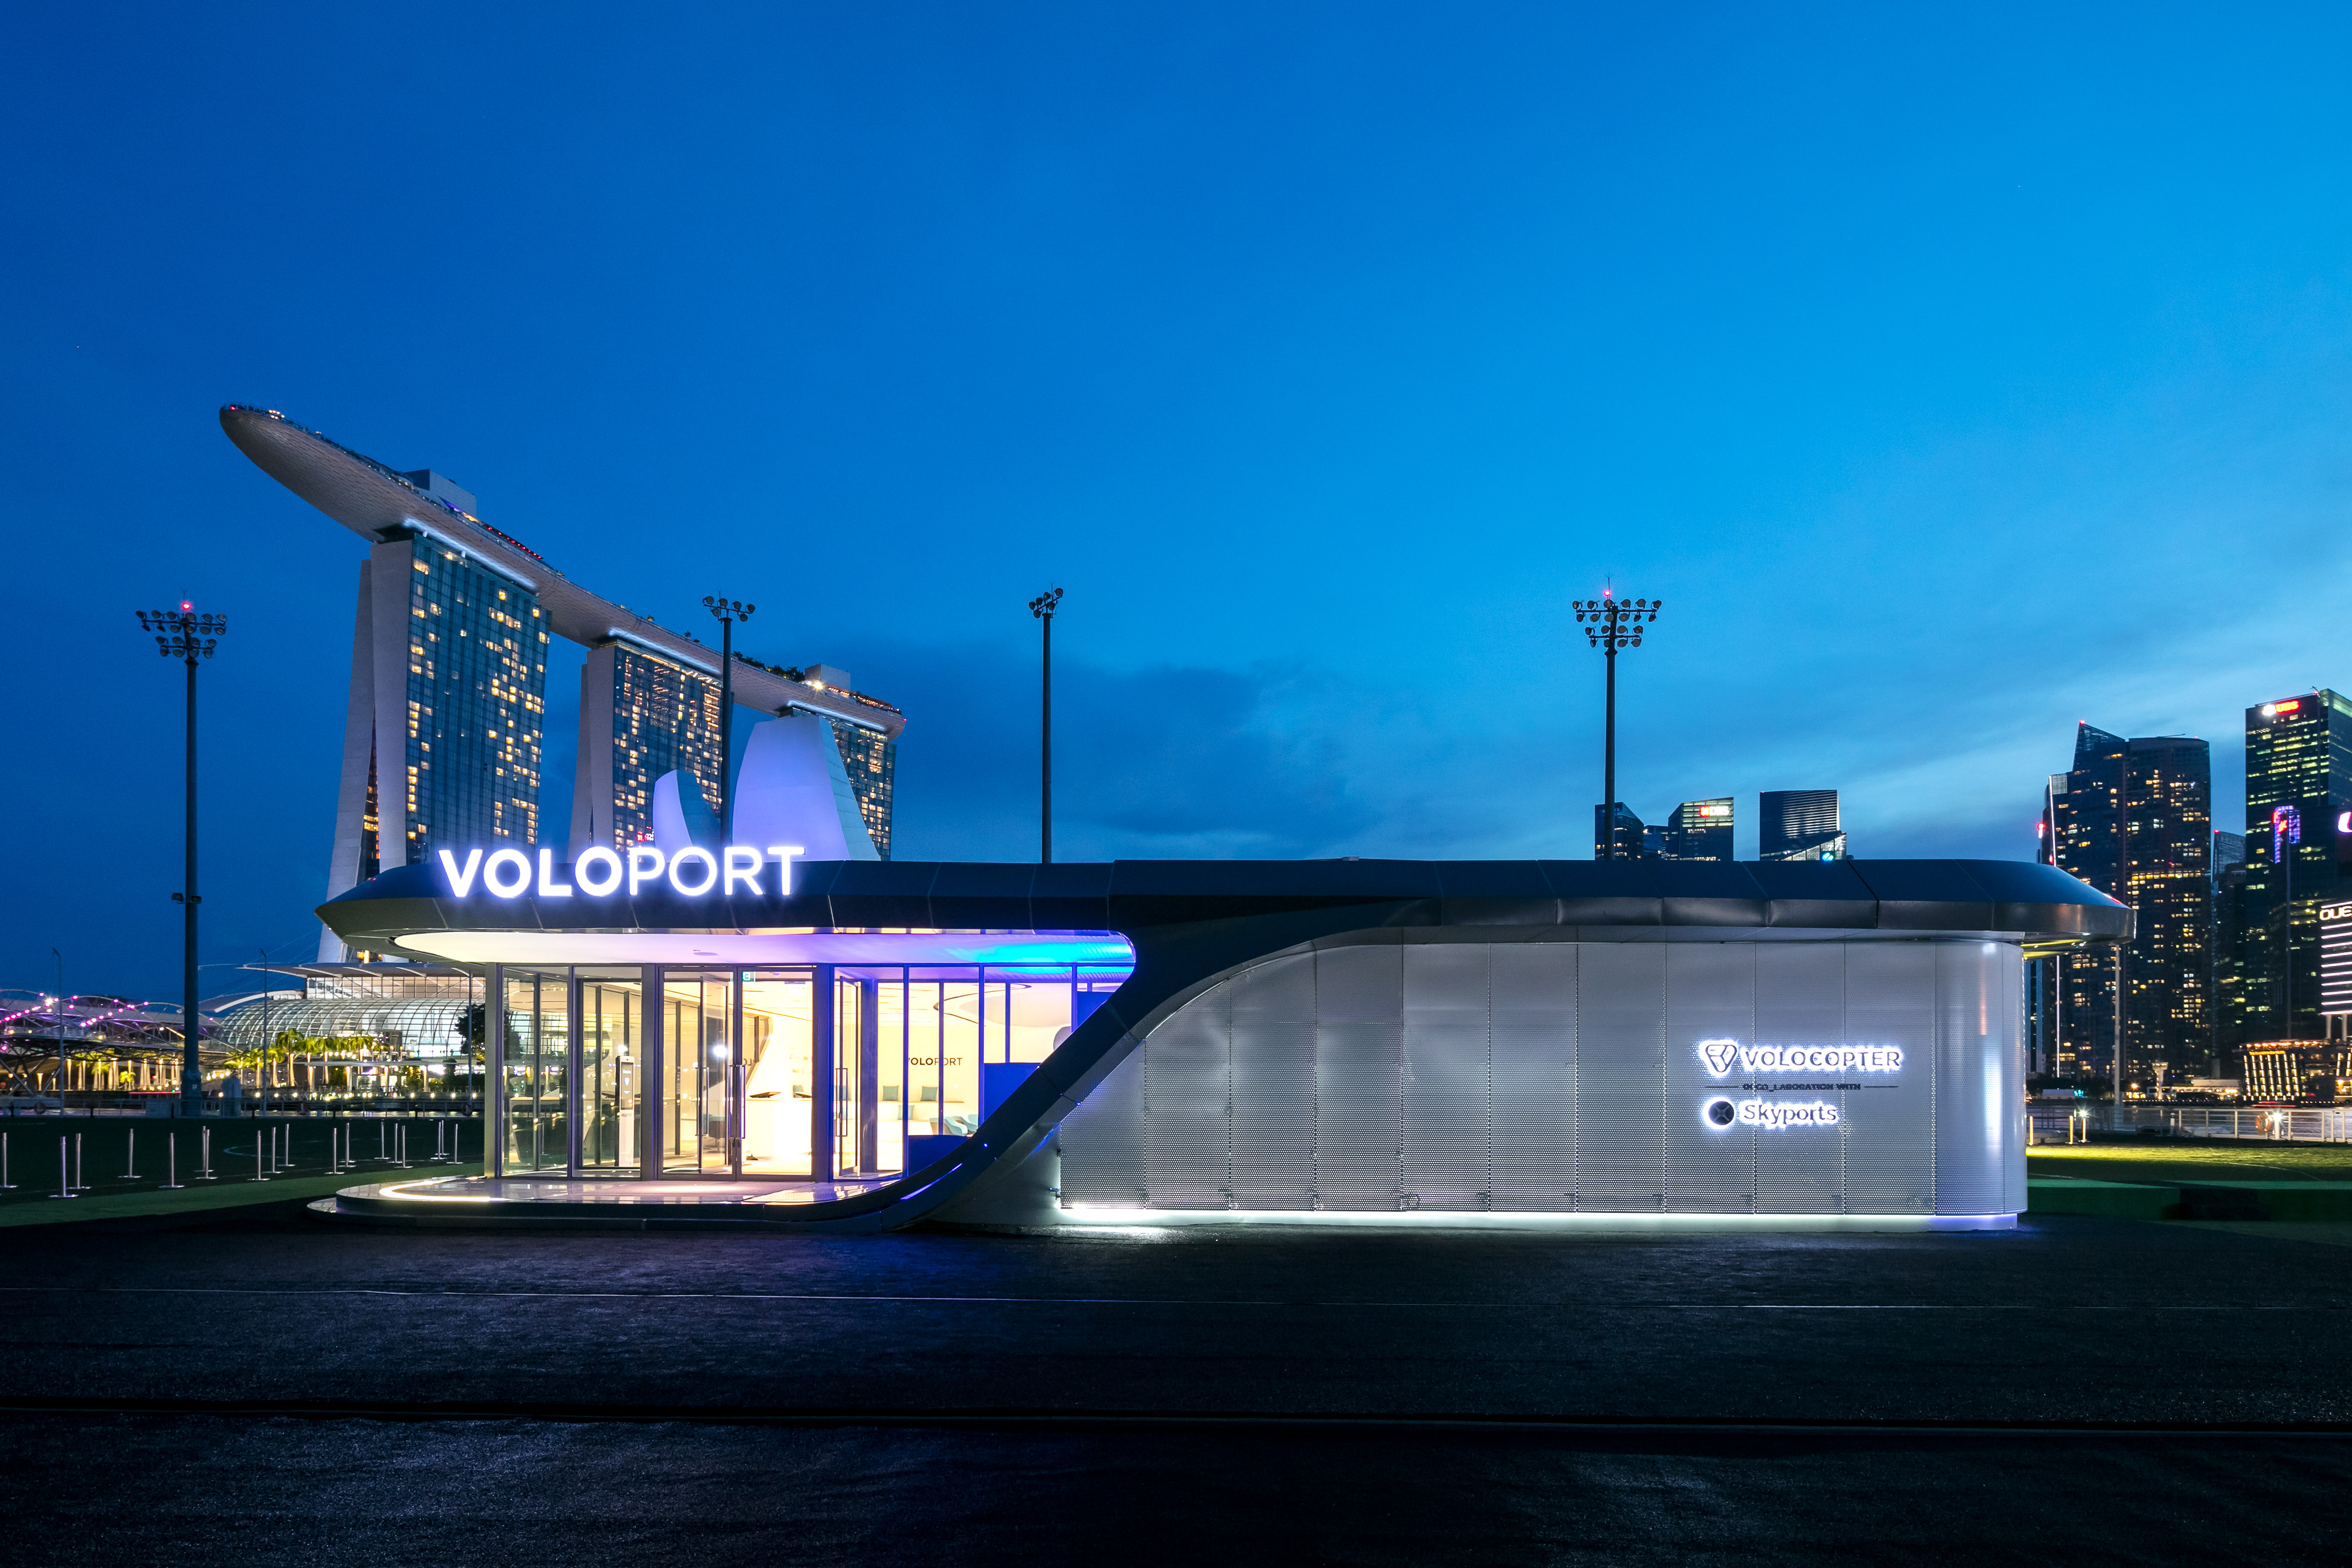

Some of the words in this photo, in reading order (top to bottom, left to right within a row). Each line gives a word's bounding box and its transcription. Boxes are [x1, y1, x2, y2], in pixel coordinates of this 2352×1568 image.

[438, 846, 805, 898] VOLOPORT
[1745, 1051, 1900, 1067] VOLOCOPTER
[1755, 1083, 1833, 1092] COLABORATION
[1743, 1104, 1837, 1125] Skyports
